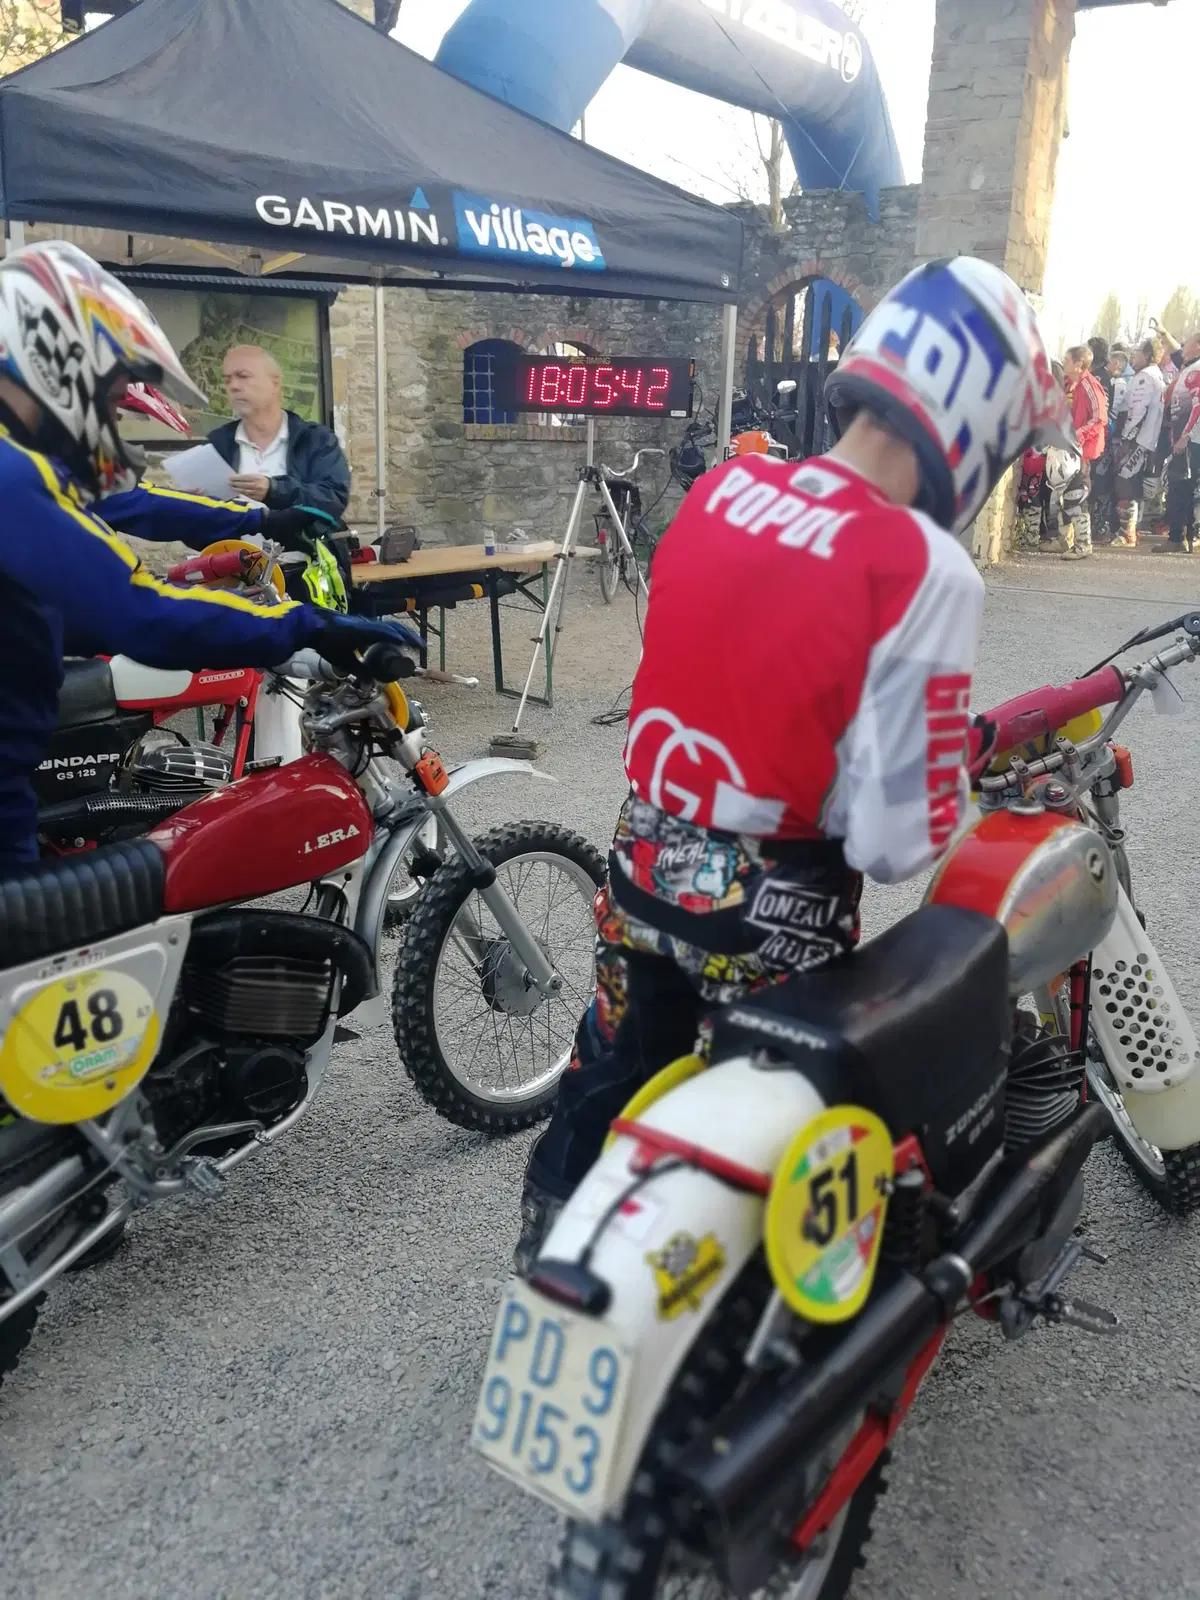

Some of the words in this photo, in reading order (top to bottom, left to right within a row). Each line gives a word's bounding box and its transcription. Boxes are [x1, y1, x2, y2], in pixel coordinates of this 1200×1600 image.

[255, 195, 440, 246] GARMIN
[464, 203, 598, 268] village
[528, 366, 671, 407] 18:05:42
[704, 466, 860, 560] POPOL
[56, 771, 74, 780] GS
[77, 768, 97, 778] 125
[54, 989, 123, 1052] 48
[802, 1150, 859, 1247] 51
[495, 1298, 566, 1389] PD
[580, 1345, 619, 1417] 9
[478, 1374, 601, 1496] 9153
